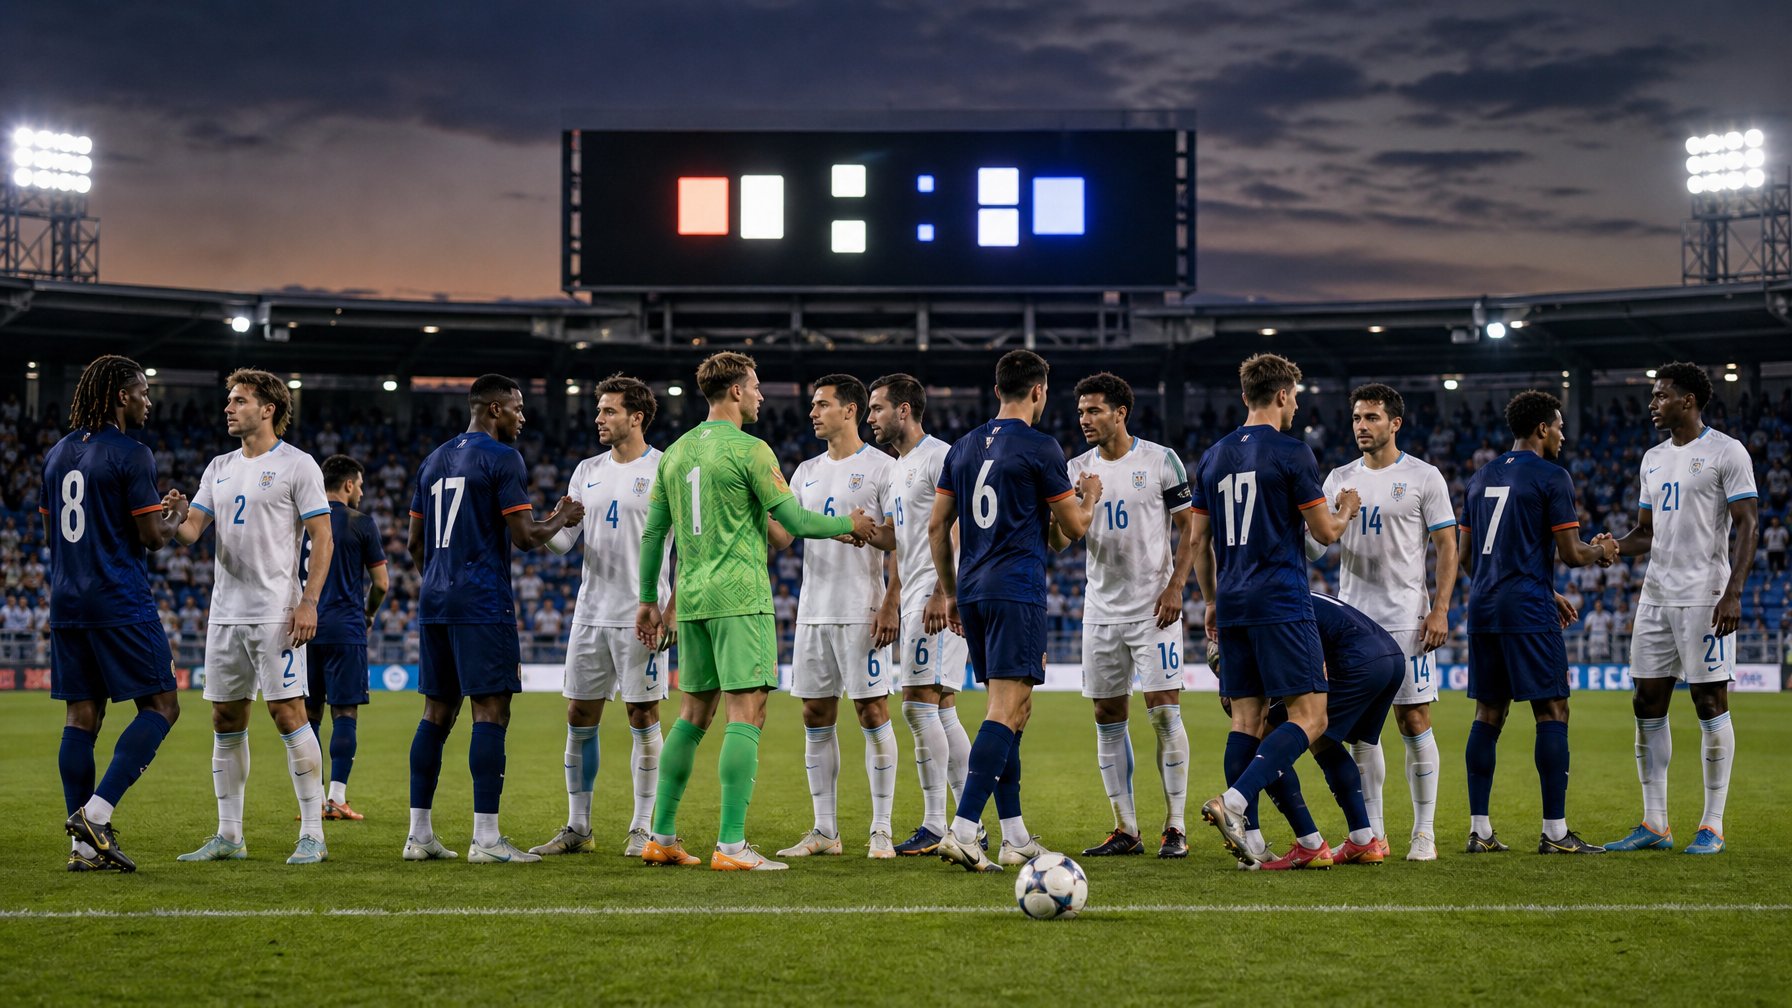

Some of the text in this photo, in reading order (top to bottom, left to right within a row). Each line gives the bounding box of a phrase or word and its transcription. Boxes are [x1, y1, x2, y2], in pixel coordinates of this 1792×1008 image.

[61, 470, 85, 542] 8
[685, 466, 702, 536] 1
[972, 460, 998, 529] 6
[1661, 481, 1681, 513] 21
[233, 495, 247, 526] 2
[431, 477, 465, 548] 17
[605, 499, 619, 529] 4
[1104, 499, 1128, 529] 16
[1218, 473, 1257, 547] 17
[1360, 505, 1382, 534] 14
[1482, 486, 1510, 555] 7
[867, 649, 881, 678] 6
[915, 637, 929, 665] 6
[1157, 641, 1179, 670] 16
[1703, 635, 1725, 663] 21
[282, 651, 297, 679] 2
[646, 653, 658, 682] 4
[1410, 655, 1431, 683] 14
